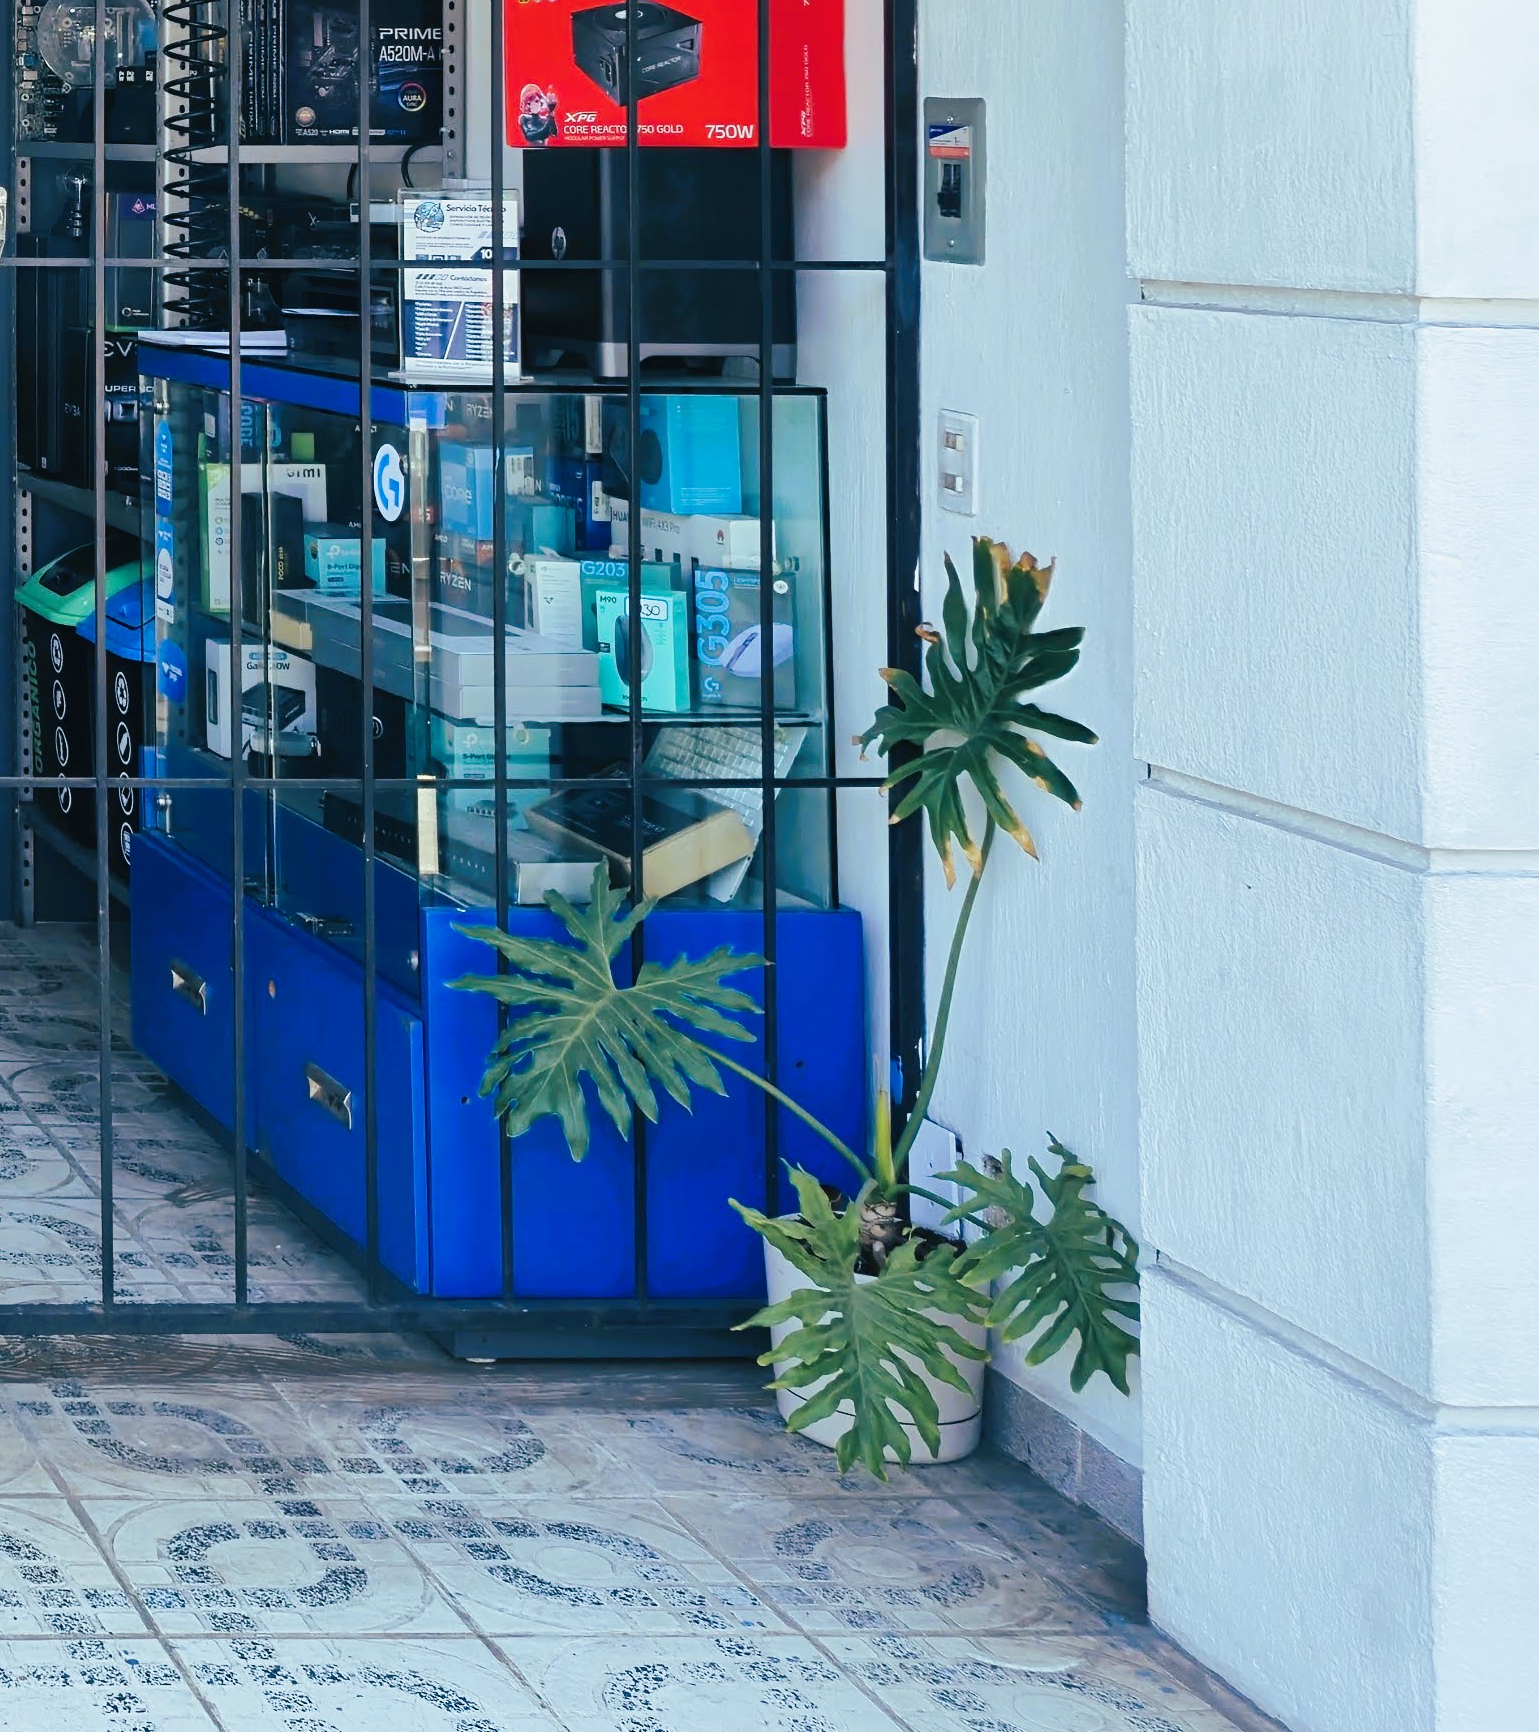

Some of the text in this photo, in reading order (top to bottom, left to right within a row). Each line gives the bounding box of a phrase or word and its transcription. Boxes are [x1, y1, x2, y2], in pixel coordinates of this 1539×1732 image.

[378, 27, 442, 40] PRIME
[641, 64, 656, 74] CORE
[402, 94, 423, 102] AURA
[563, 111, 598, 123] XPG
[563, 124, 754, 139] CORE REACTO 750 GOLD 750W
[446, 204, 477, 213] Servicio
[581, 560, 626, 578] G203
[439, 571, 472, 592] RYZEN
[599, 595, 617, 604] M90
[694, 570, 730, 667] G305
[24, 640, 43, 774] ORGANICO
